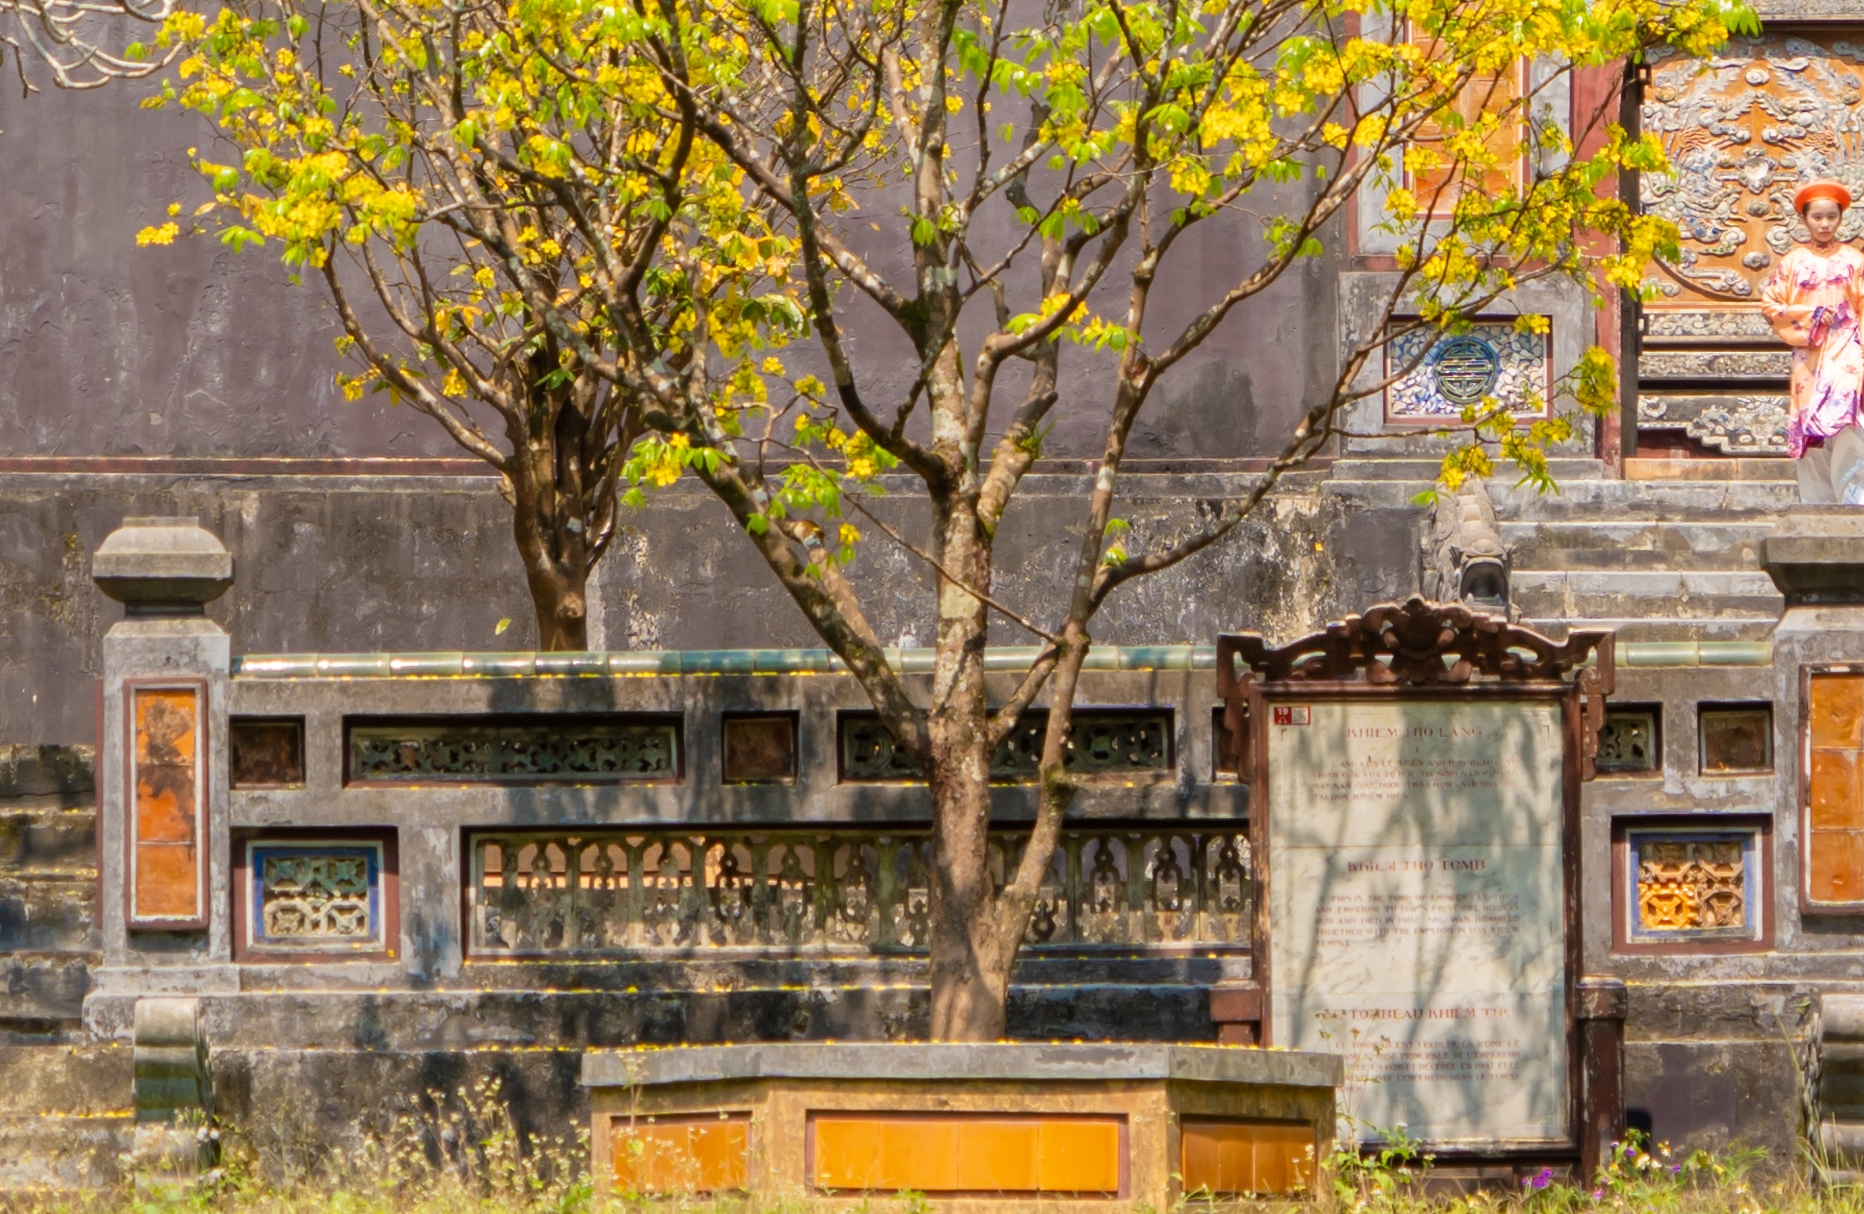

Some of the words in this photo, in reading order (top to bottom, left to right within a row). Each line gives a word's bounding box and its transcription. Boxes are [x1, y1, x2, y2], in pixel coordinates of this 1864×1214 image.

[1277, 707, 1289, 716] 19
[1442, 860, 1486, 872] TOMB
[1338, 917, 1357, 925] AND
